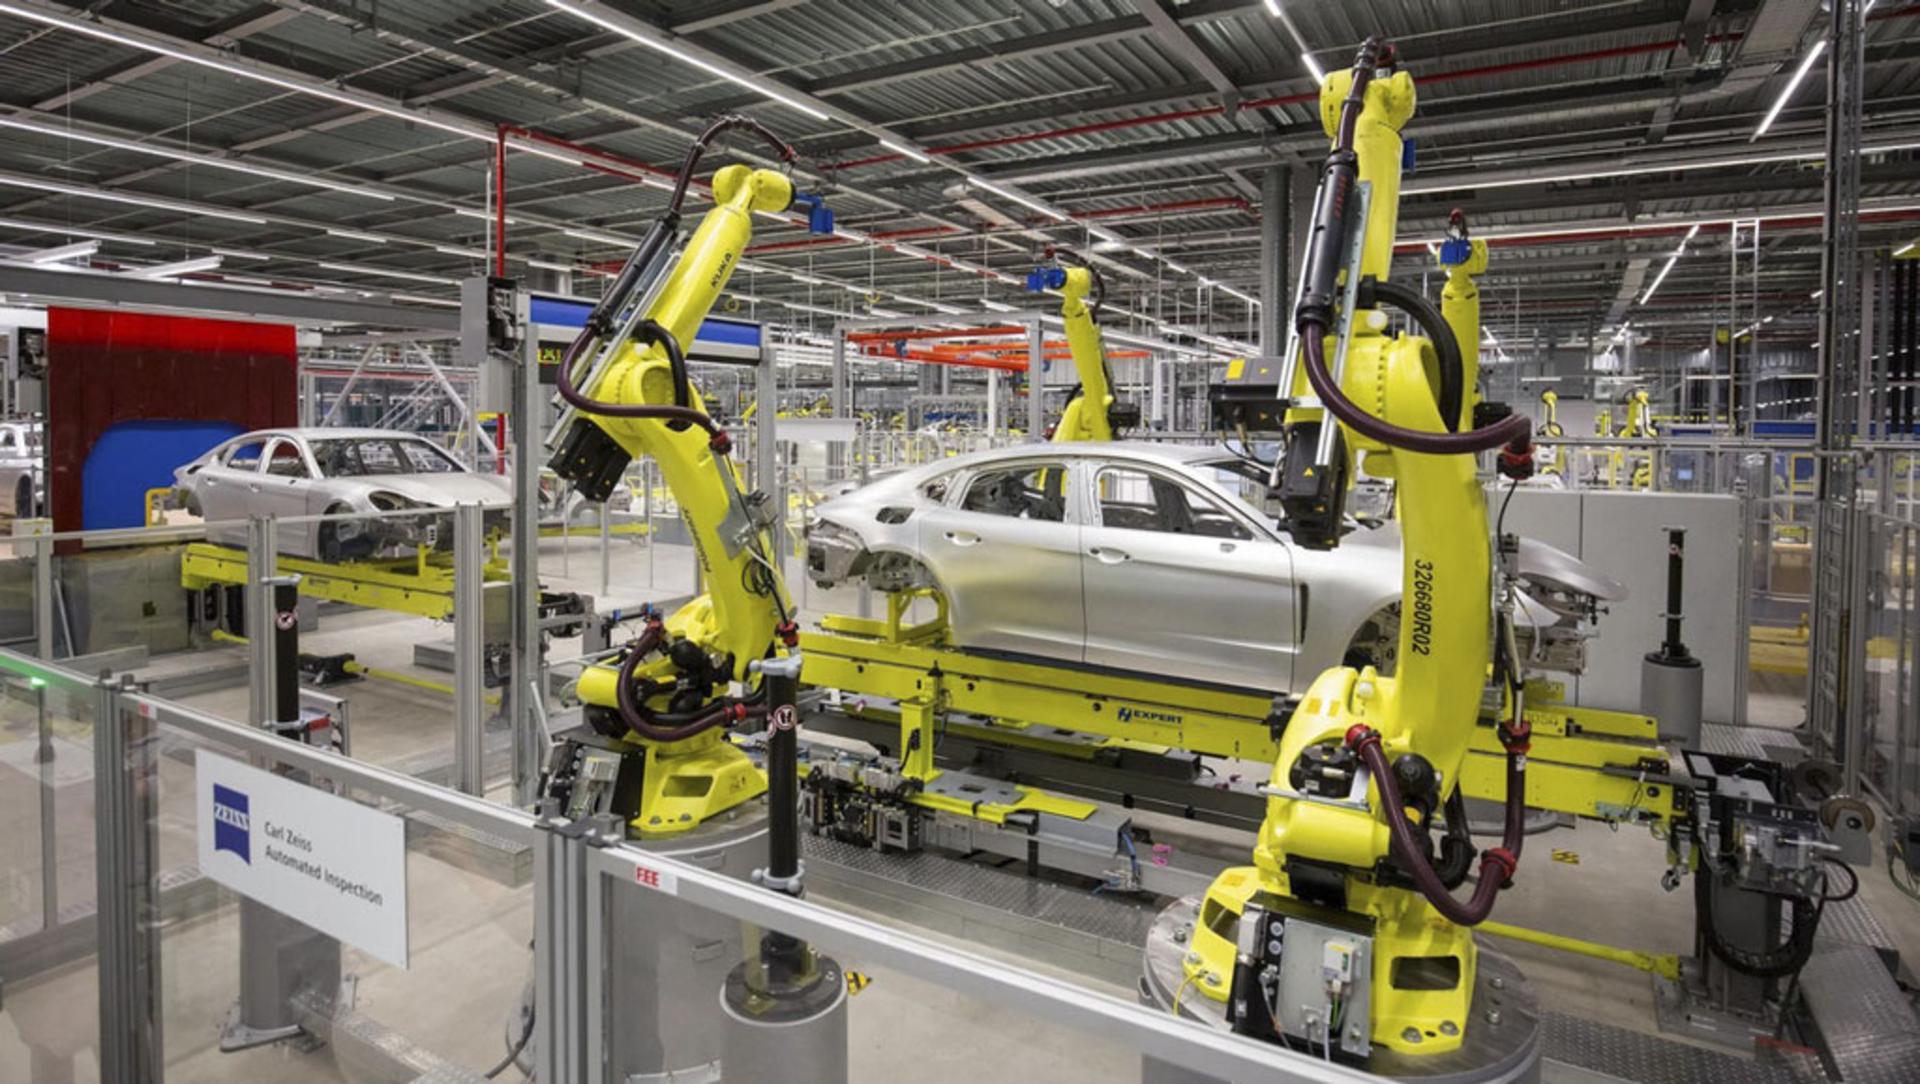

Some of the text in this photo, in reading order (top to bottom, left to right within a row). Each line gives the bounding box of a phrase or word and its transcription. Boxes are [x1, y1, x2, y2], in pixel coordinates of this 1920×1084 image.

[1411, 559, 1434, 656] 326680R02
[1133, 709, 1184, 724] EXPERT
[213, 801, 250, 831] ZEISS
[264, 821, 313, 853] Carl Zeiss
[265, 844, 383, 907] Automated Inspection
[636, 866, 659, 887] FEE
